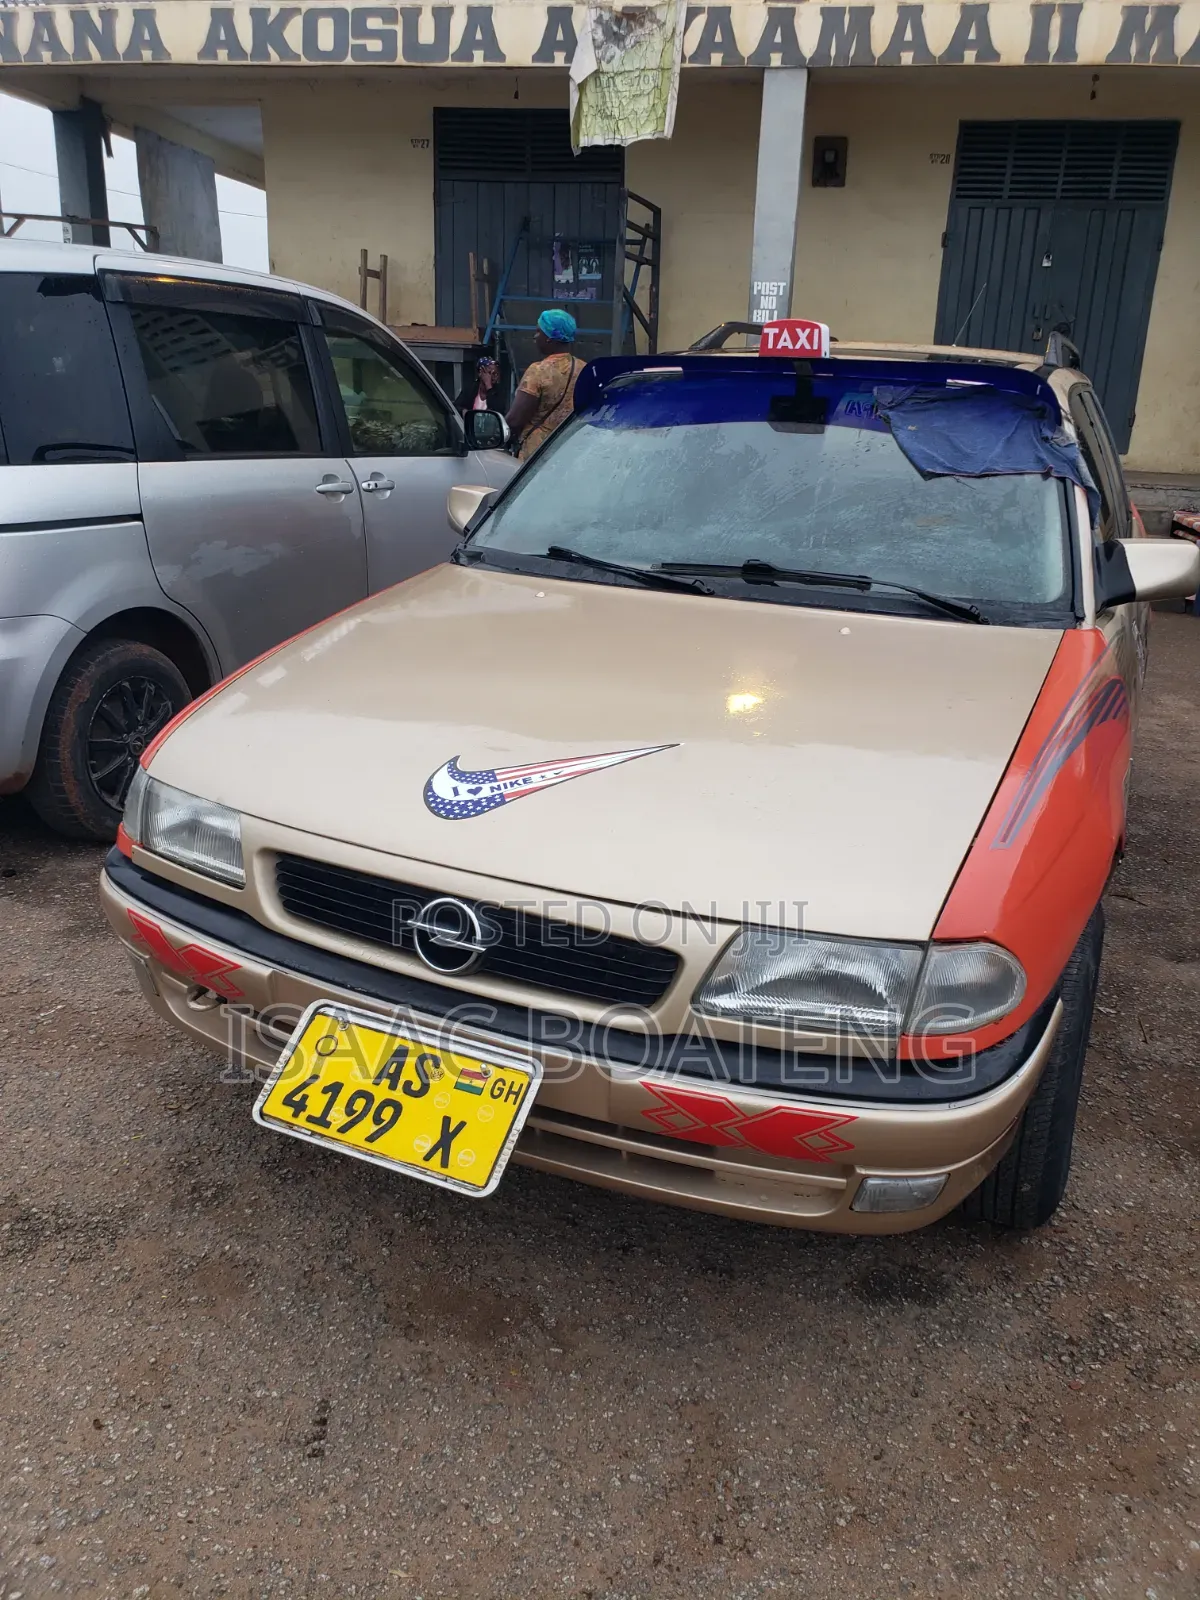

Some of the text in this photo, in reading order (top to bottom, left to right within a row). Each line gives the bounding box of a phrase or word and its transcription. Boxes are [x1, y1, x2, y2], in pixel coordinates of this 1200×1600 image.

[200, 7, 506, 63] AKOSUA
[753, 281, 787, 296] POST
[760, 295, 777, 310] NO
[763, 328, 819, 350] TAXI
[451, 776, 533, 797] I NIKE
[372, 1044, 525, 1106] AS GH
[281, 1073, 404, 1144] 4199
[422, 1114, 467, 1169] X
